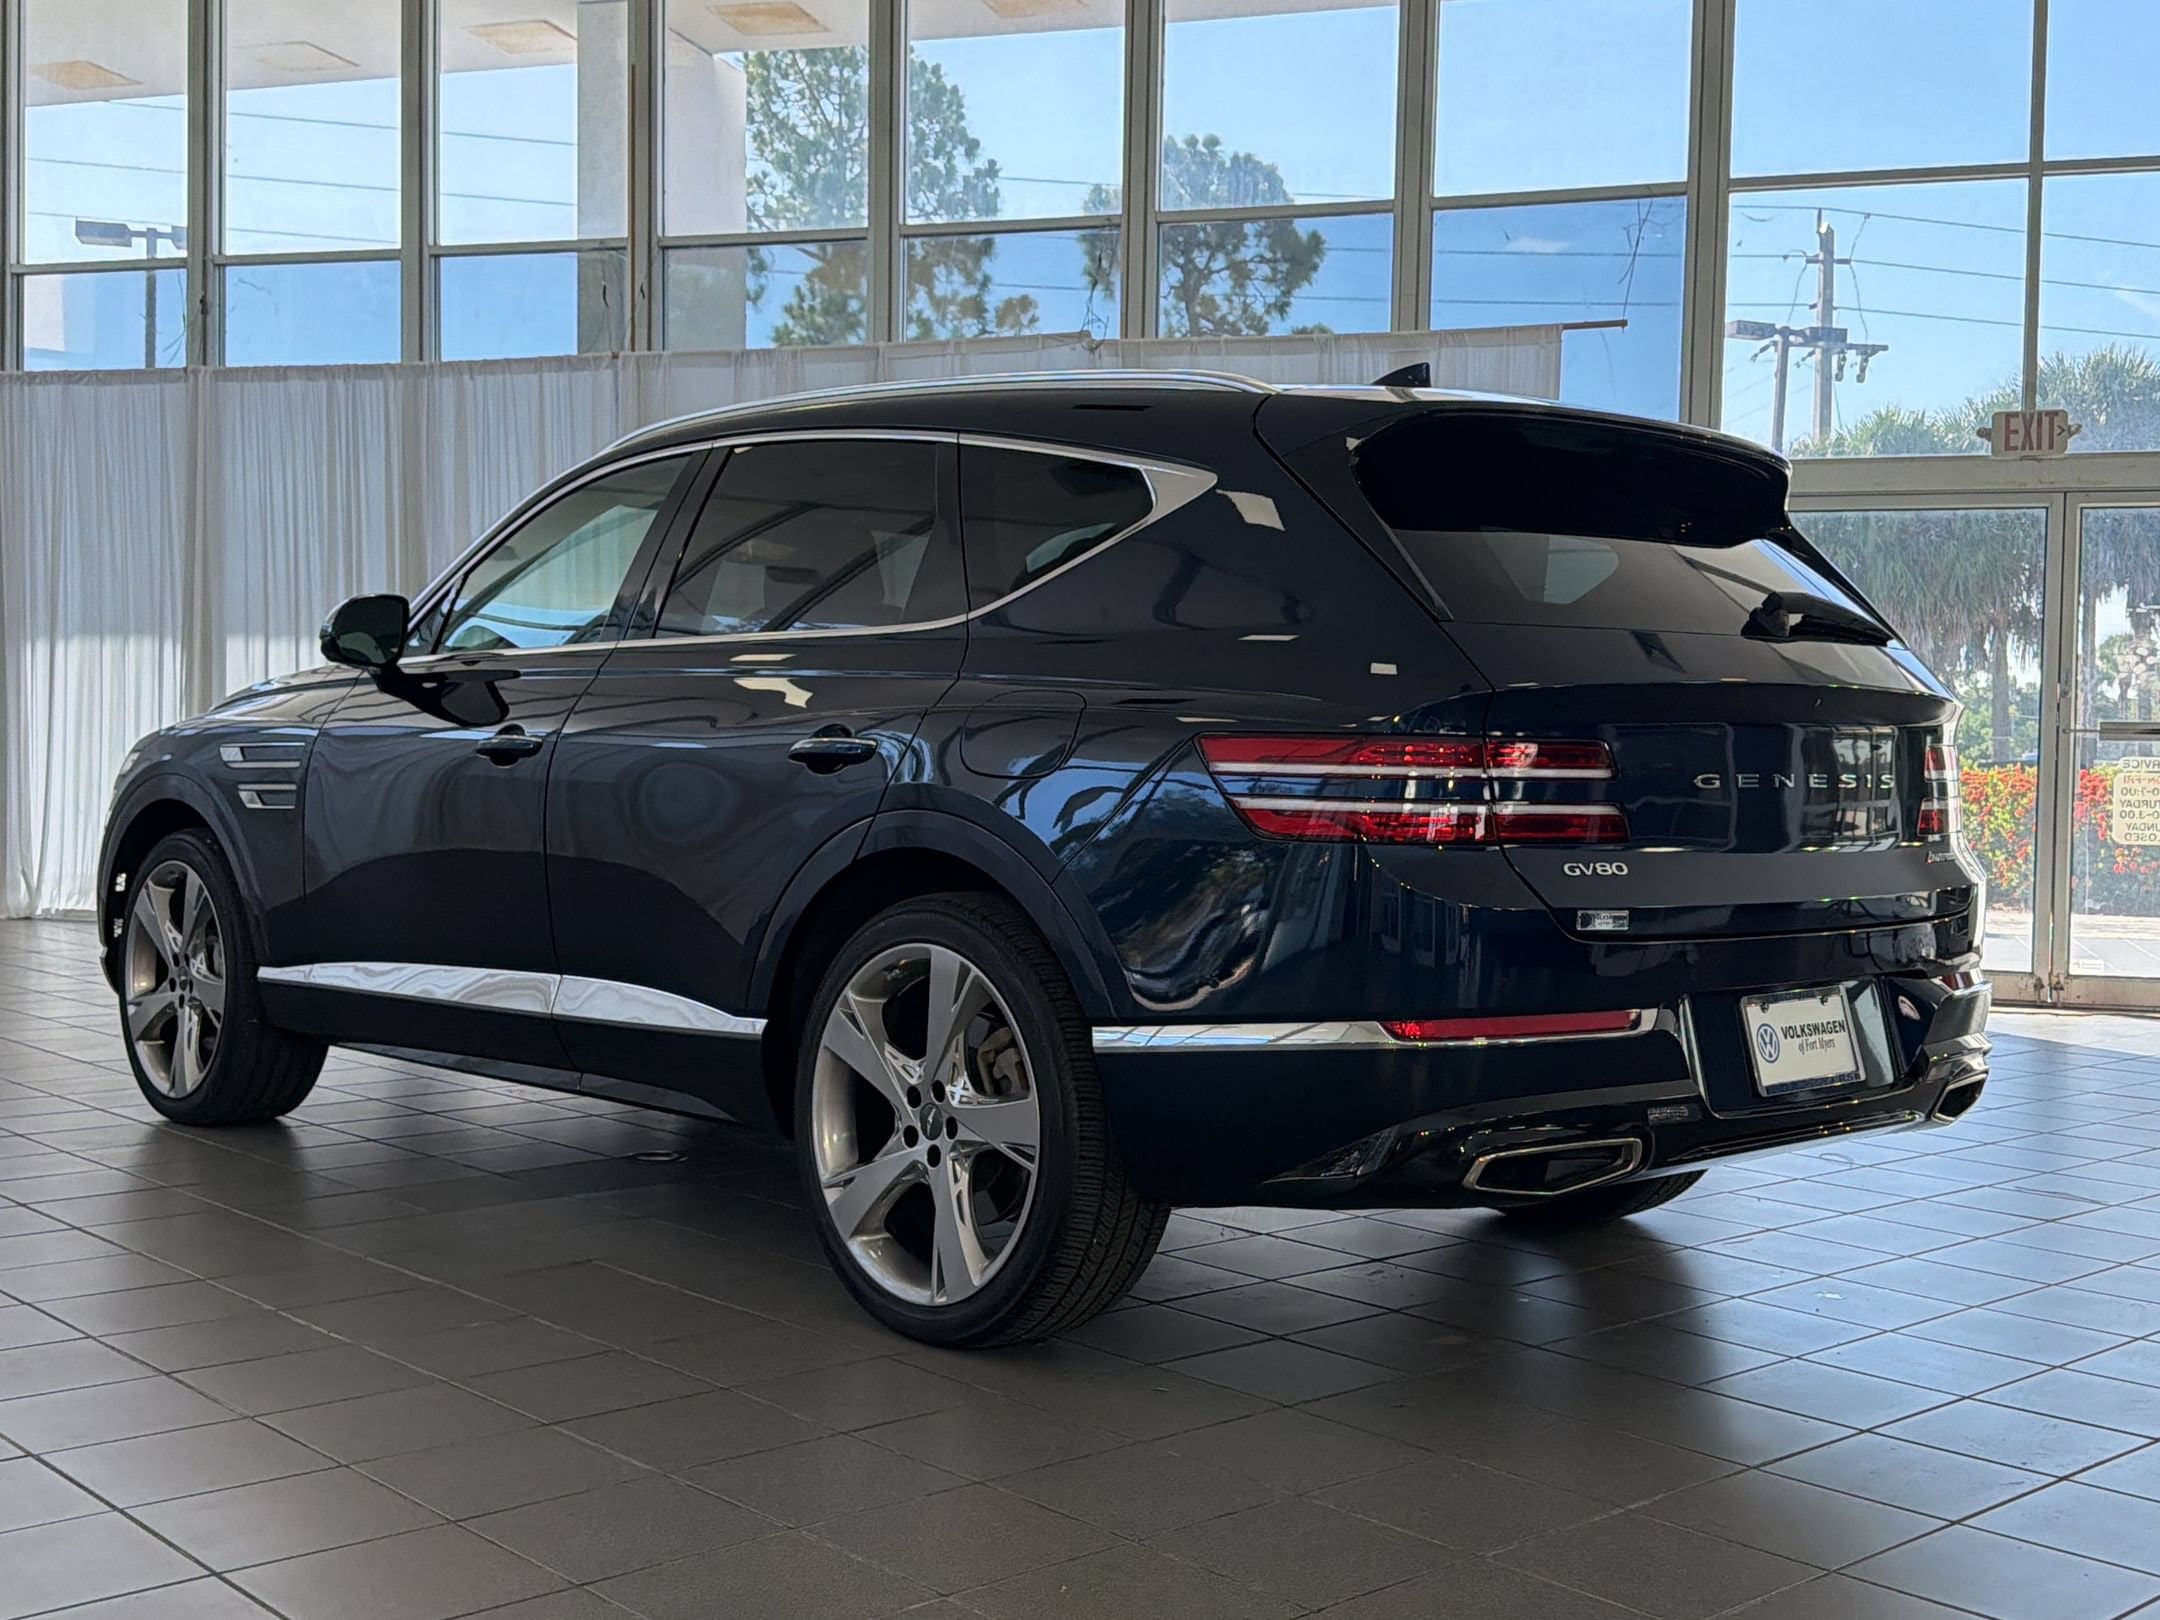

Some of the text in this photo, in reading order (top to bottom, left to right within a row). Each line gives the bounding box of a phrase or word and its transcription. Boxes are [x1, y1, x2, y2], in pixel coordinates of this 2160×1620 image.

[2004, 412, 2059, 451] EXIT
[1693, 773, 1896, 789] GENESIS
[1563, 862, 1629, 876] GV80
[1780, 1020, 1846, 1041] VOLKSWAGEN
[1798, 1037, 1836, 1056] of Fort Myers
